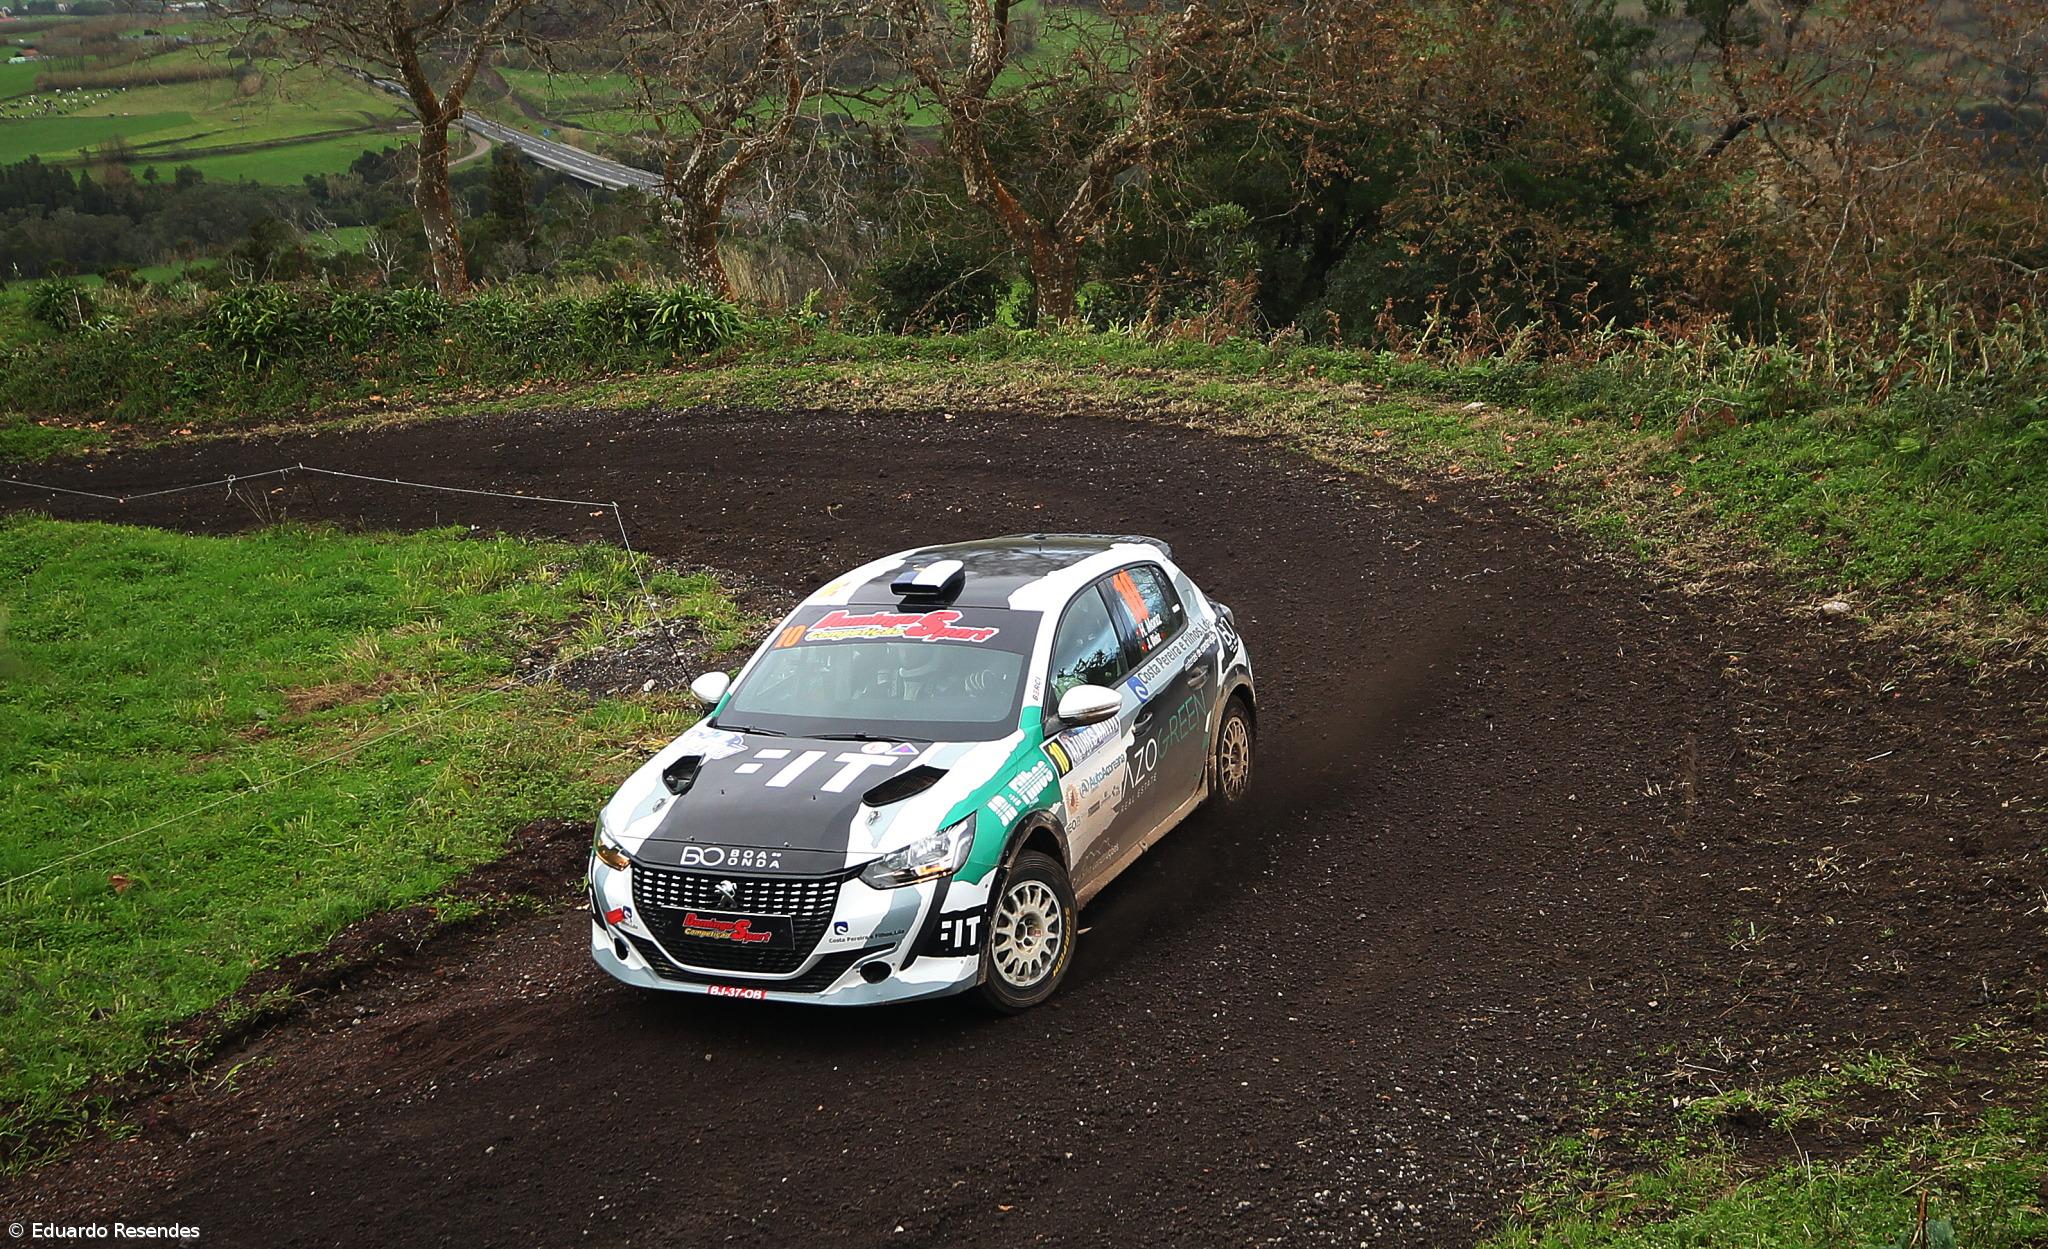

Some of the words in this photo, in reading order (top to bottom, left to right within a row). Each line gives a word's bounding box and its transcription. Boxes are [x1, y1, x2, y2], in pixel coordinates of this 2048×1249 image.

[1111, 569, 1149, 624] 10
[774, 624, 807, 649] 10
[1137, 664, 1161, 684] Costa
[1156, 639, 1182, 670] Pereira
[1158, 687, 1208, 759] GREEN
[1049, 741, 1070, 775] 10
[727, 857, 780, 869] ONDA
